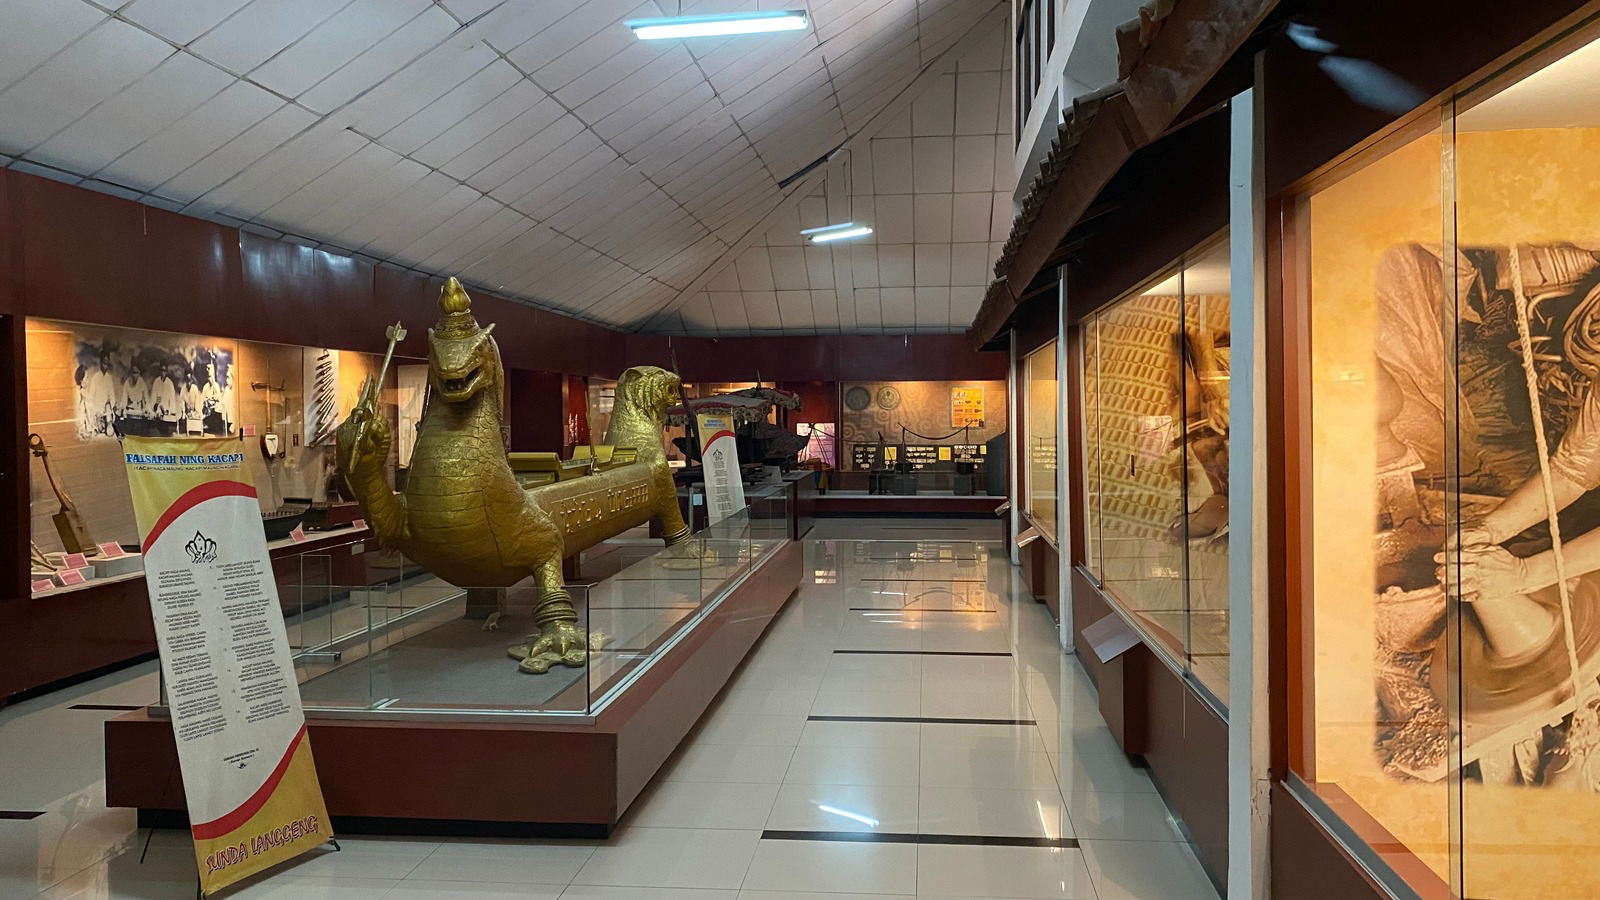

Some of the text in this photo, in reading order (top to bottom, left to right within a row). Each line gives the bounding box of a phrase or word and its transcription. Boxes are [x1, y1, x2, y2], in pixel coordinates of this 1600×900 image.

[126, 453, 244, 465] FALSAFAH NING KACAPI
[206, 815, 319, 875] SUNDA LANGGENG
